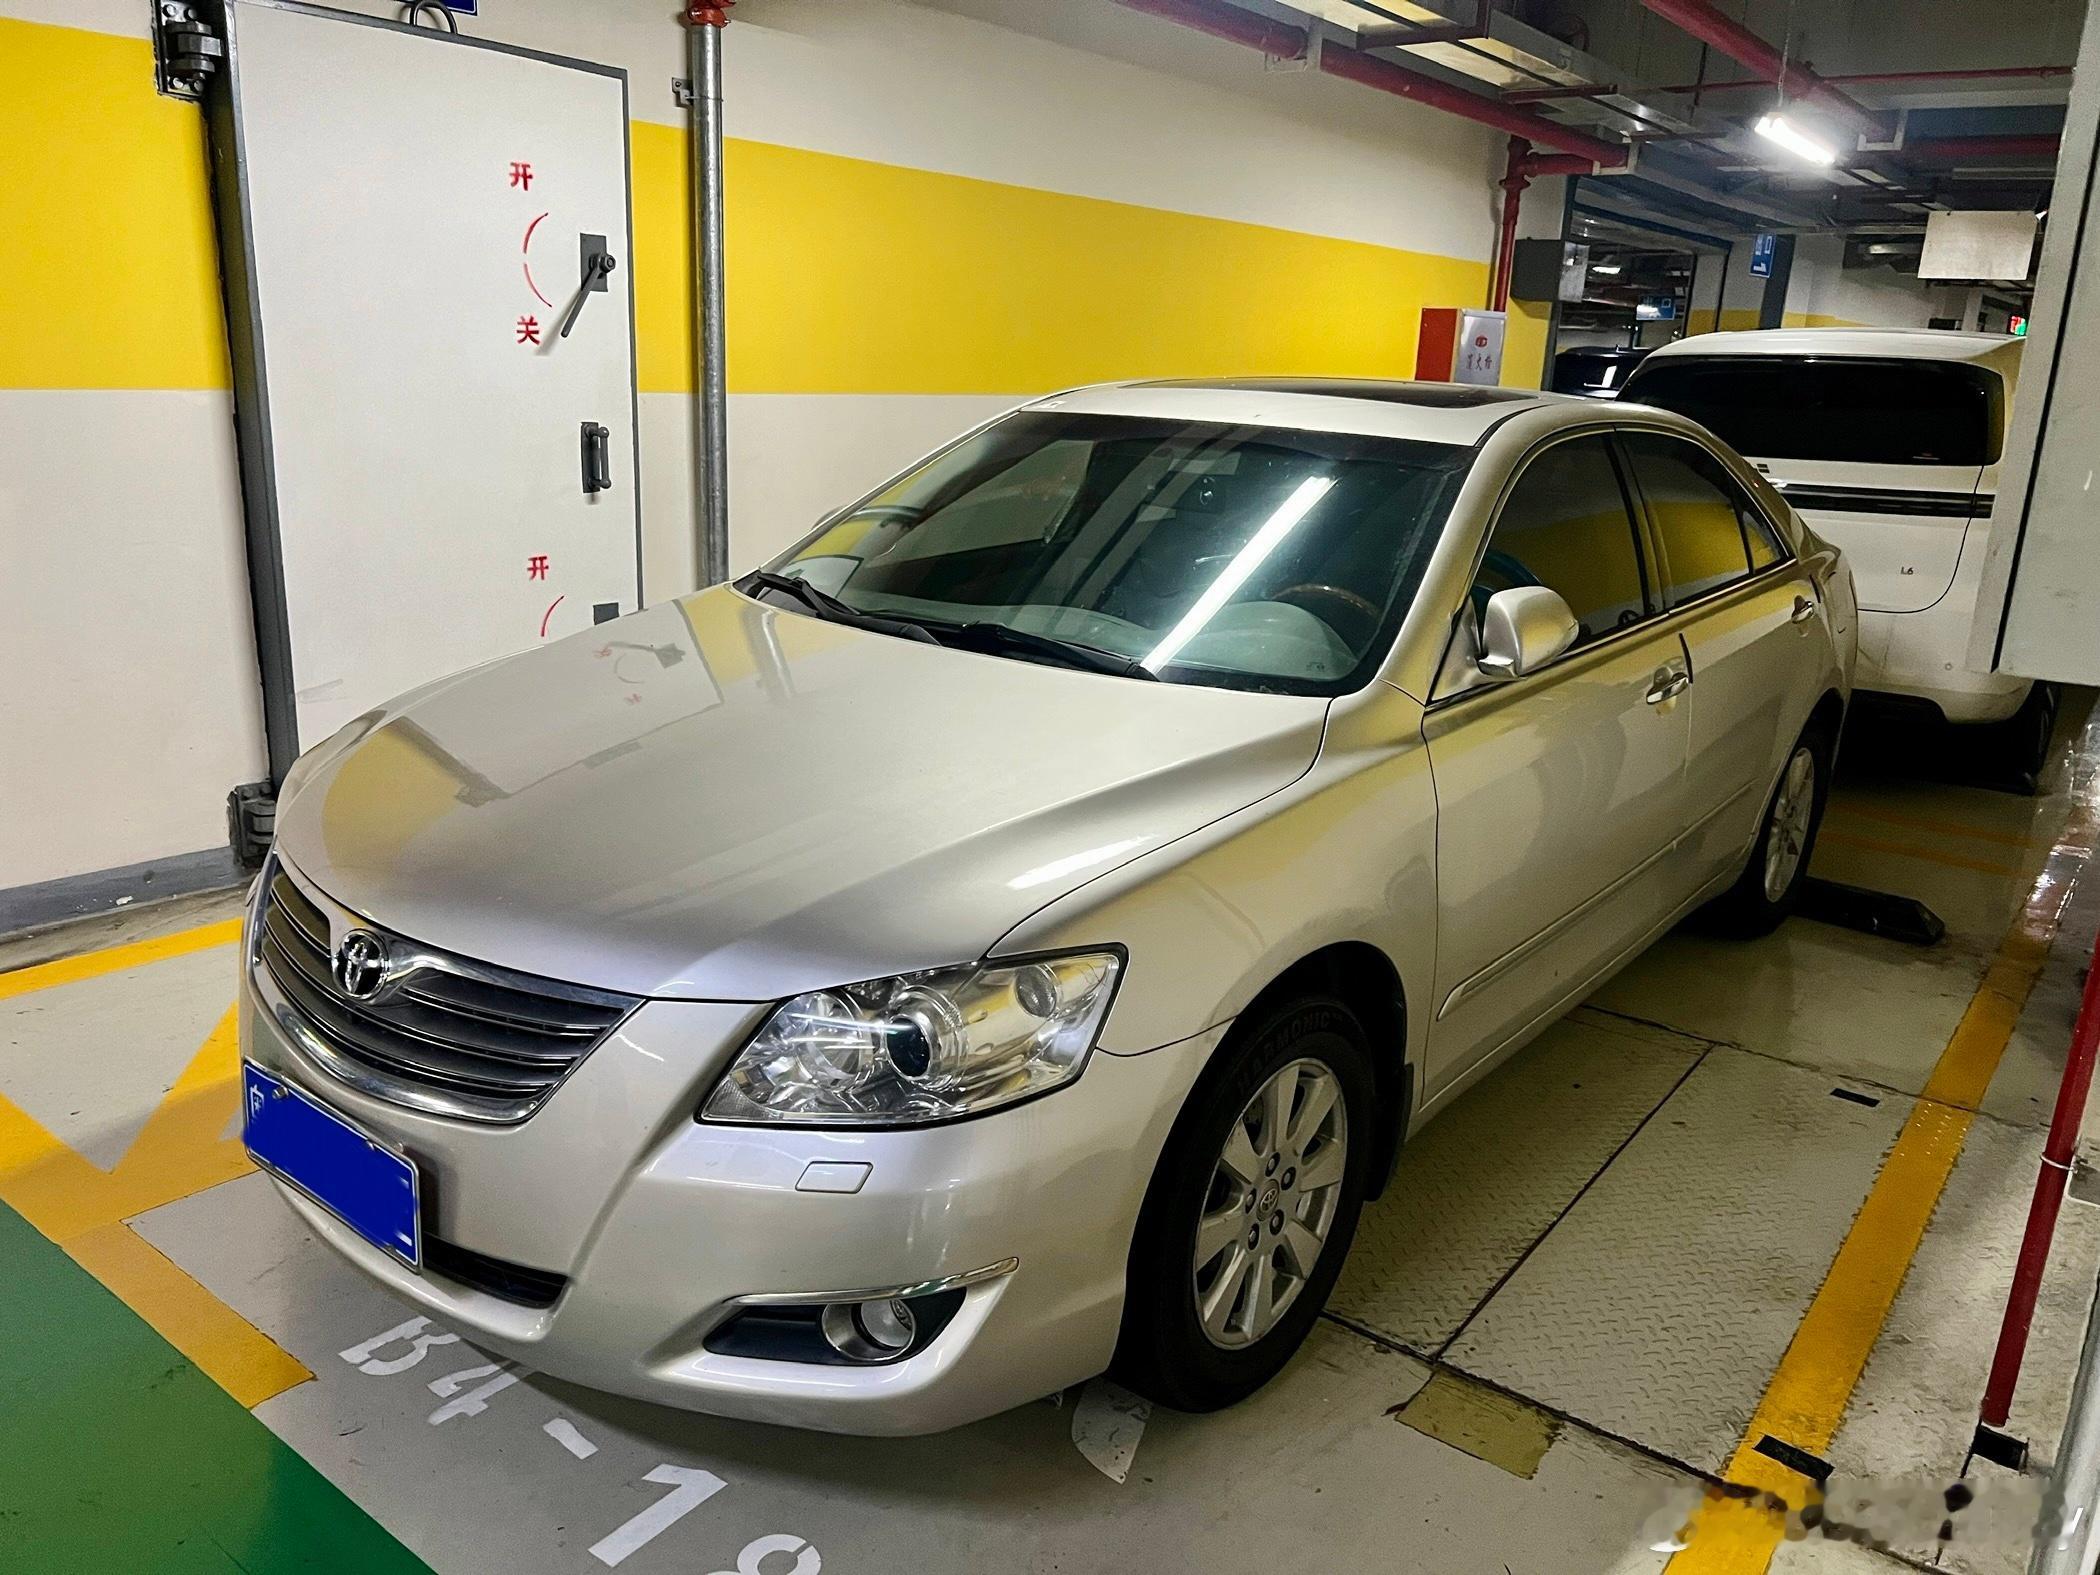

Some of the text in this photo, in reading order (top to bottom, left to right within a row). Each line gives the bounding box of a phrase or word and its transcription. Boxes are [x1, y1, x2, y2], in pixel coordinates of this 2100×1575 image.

[509, 161, 533, 191] 开
[516, 315, 540, 345] 关
[527, 555, 549, 581] 开
[1900, 566, 1914, 576] L6
